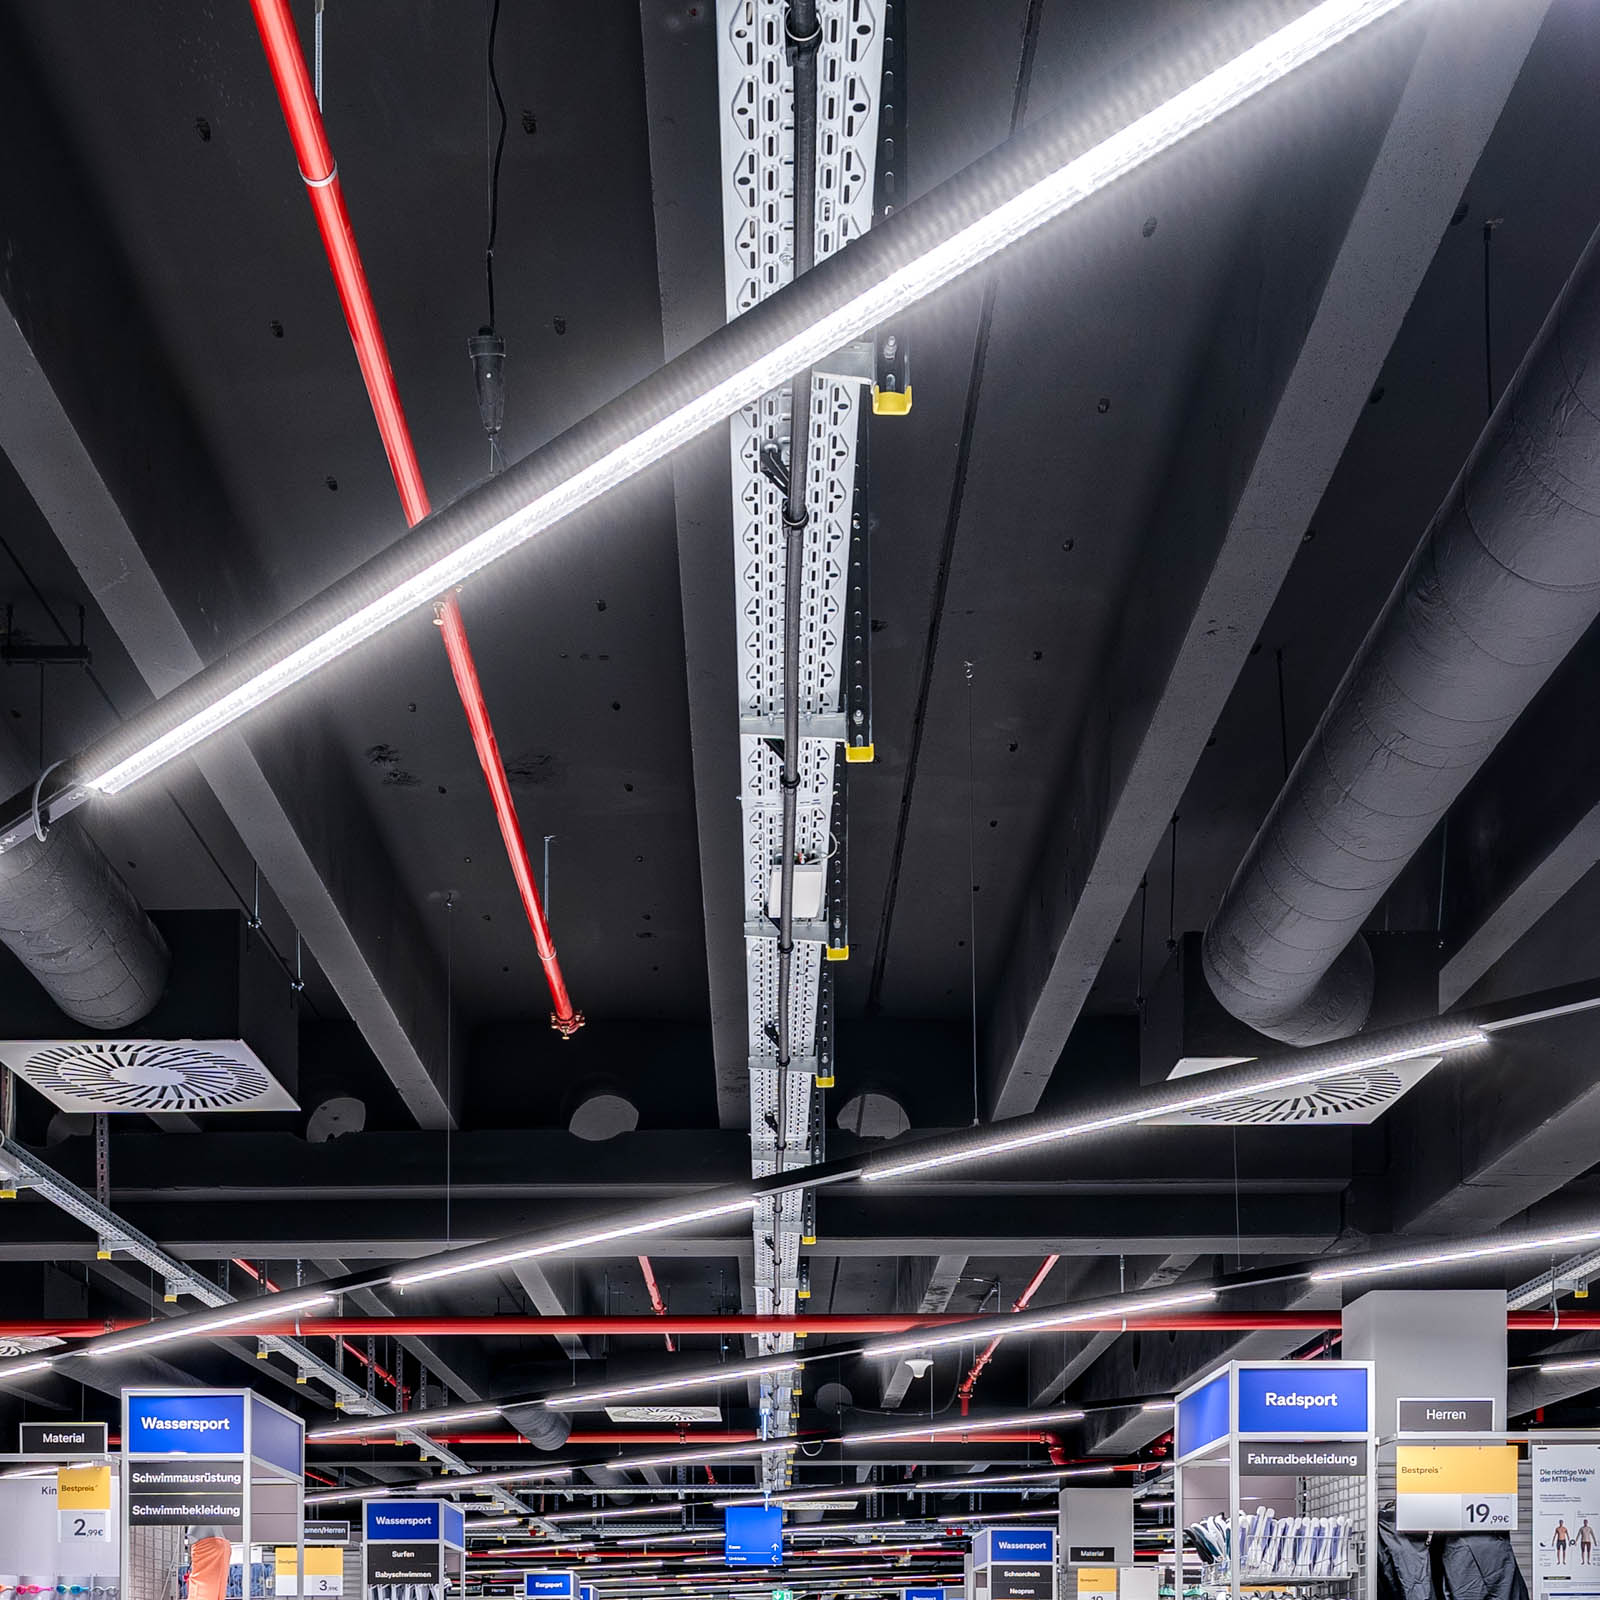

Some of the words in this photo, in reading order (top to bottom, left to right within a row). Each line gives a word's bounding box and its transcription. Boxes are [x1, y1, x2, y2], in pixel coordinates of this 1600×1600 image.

[1265, 1393, 1338, 1408] Radsport
[1426, 1408, 1467, 1421] Herren
[141, 1417, 230, 1432] Wassersport
[42, 1433, 85, 1443] Material
[1248, 1453, 1357, 1466] Fahrradbekleidung
[1402, 1466, 1440, 1475] Bestpreis
[1540, 1468, 1551, 1476] Die
[1551, 1468, 1577, 1478] richtige
[1578, 1468, 1596, 1476] Wahl
[132, 1473, 241, 1485] Schwimmausrüstung
[61, 1484, 95, 1492] Bestpreis
[132, 1505, 240, 1517] Schwimmbekleidung
[1465, 1503, 1510, 1525] 19,99€
[376, 1516, 432, 1526] Wassersport
[304, 1527, 346, 1535] amen/Herren
[999, 1541, 1047, 1551] Wassersport
[391, 1550, 415, 1558] Surfen
[375, 1571, 431, 1580] Babyschwimmen
